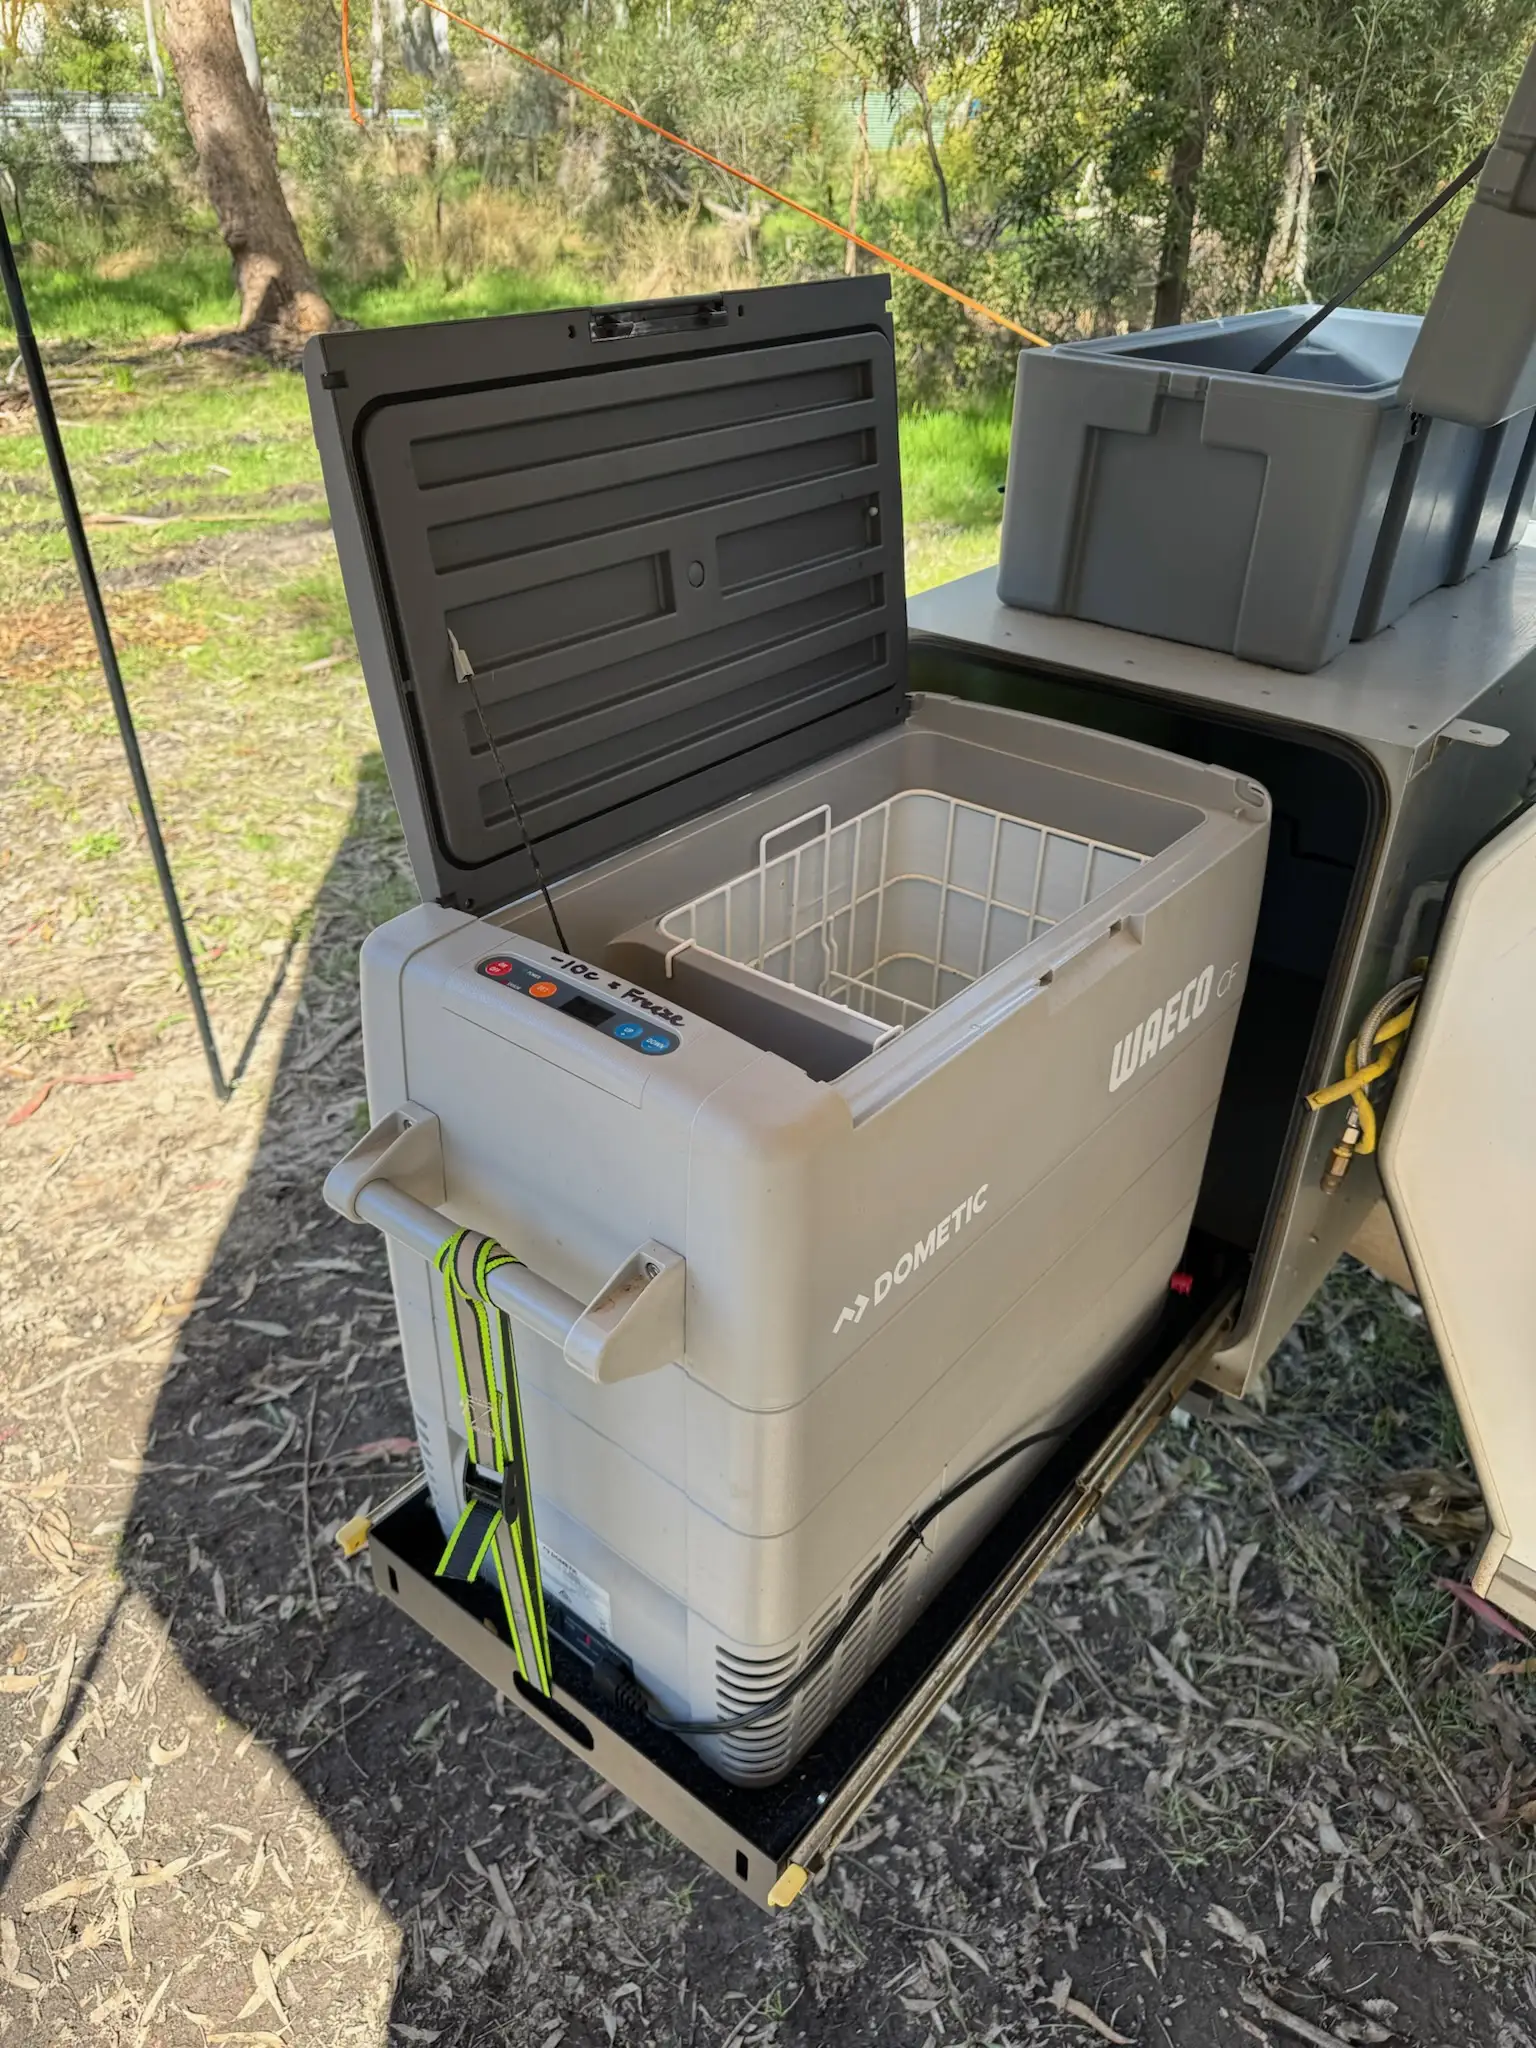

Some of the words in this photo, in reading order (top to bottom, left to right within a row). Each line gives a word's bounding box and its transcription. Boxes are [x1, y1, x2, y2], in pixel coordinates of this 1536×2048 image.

[646, 1037, 665, 1049] DOWN
[1109, 964, 1215, 1092] WAECO
[1217, 961, 1240, 998] CF
[874, 1183, 989, 1306] DOMETIC
